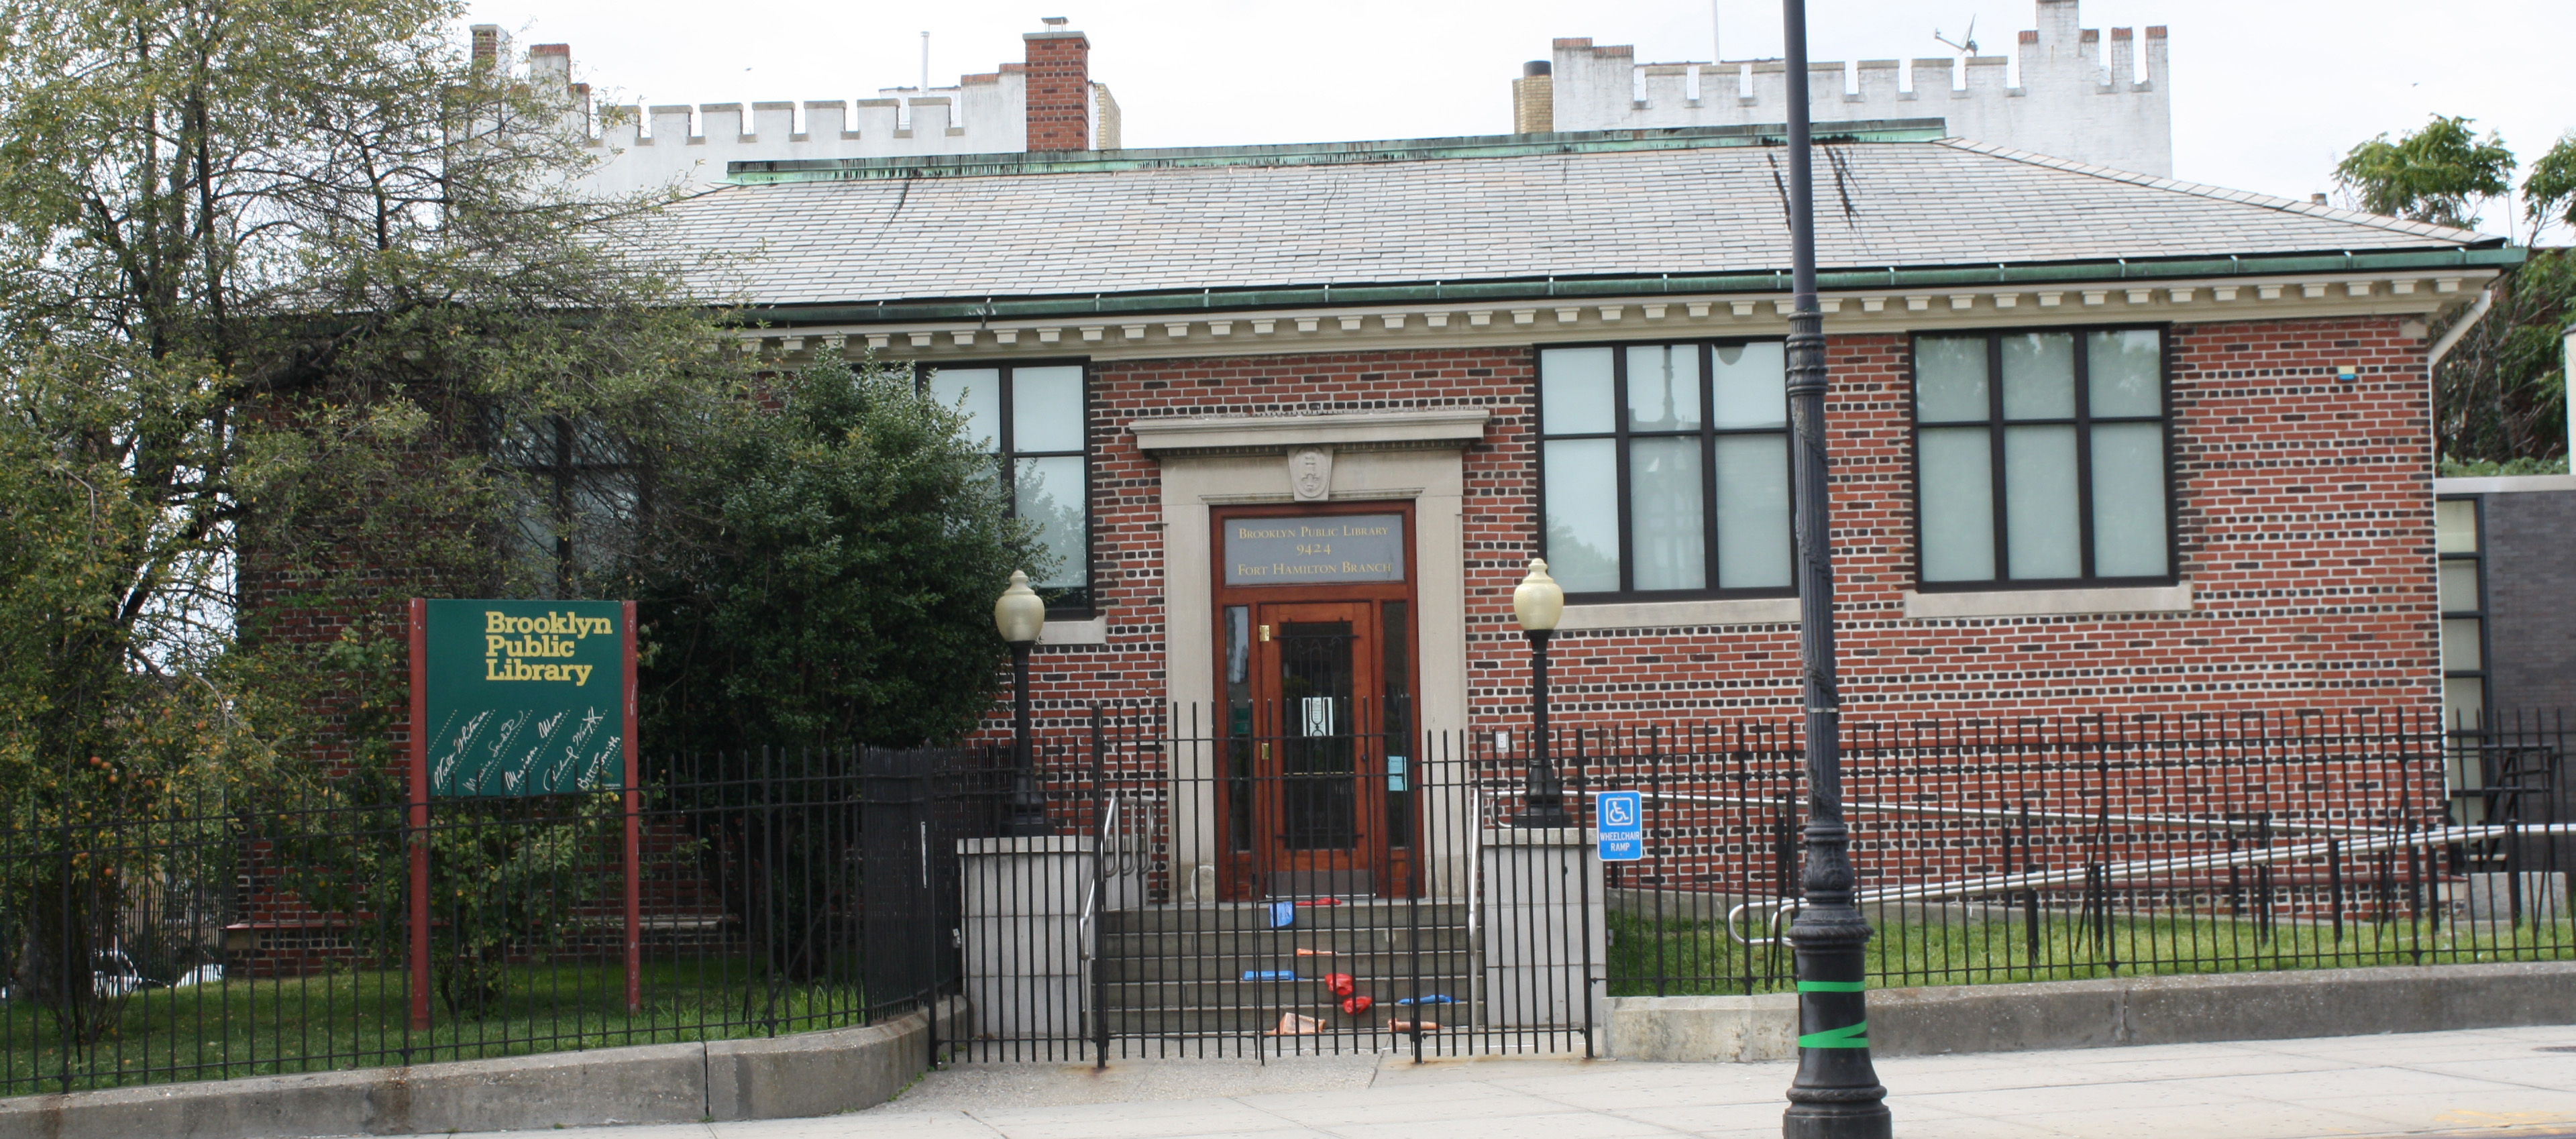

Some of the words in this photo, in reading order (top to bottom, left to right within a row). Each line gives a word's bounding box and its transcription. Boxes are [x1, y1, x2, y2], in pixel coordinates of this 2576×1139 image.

[1238, 528, 1296, 539] BROOKLYN
[1300, 526, 1338, 537] PUBLIC
[1343, 525, 1389, 537] LIBRARY
[1296, 543, 1332, 556] 9424
[1238, 563, 1268, 576] FORT
[1273, 563, 1337, 575] HAMILTON
[1342, 561, 1392, 574] BRANCH
[485, 611, 612, 639] Brooklyn
[485, 635, 575, 657] Public
[485, 658, 592, 687] Library
[433, 752, 456, 790] Walt
[453, 710, 489, 754] Whitman
[462, 759, 494, 792] Murice
[1599, 831, 1640, 841] WHEELCHAIR
[1611, 842, 1630, 852] RAMP
